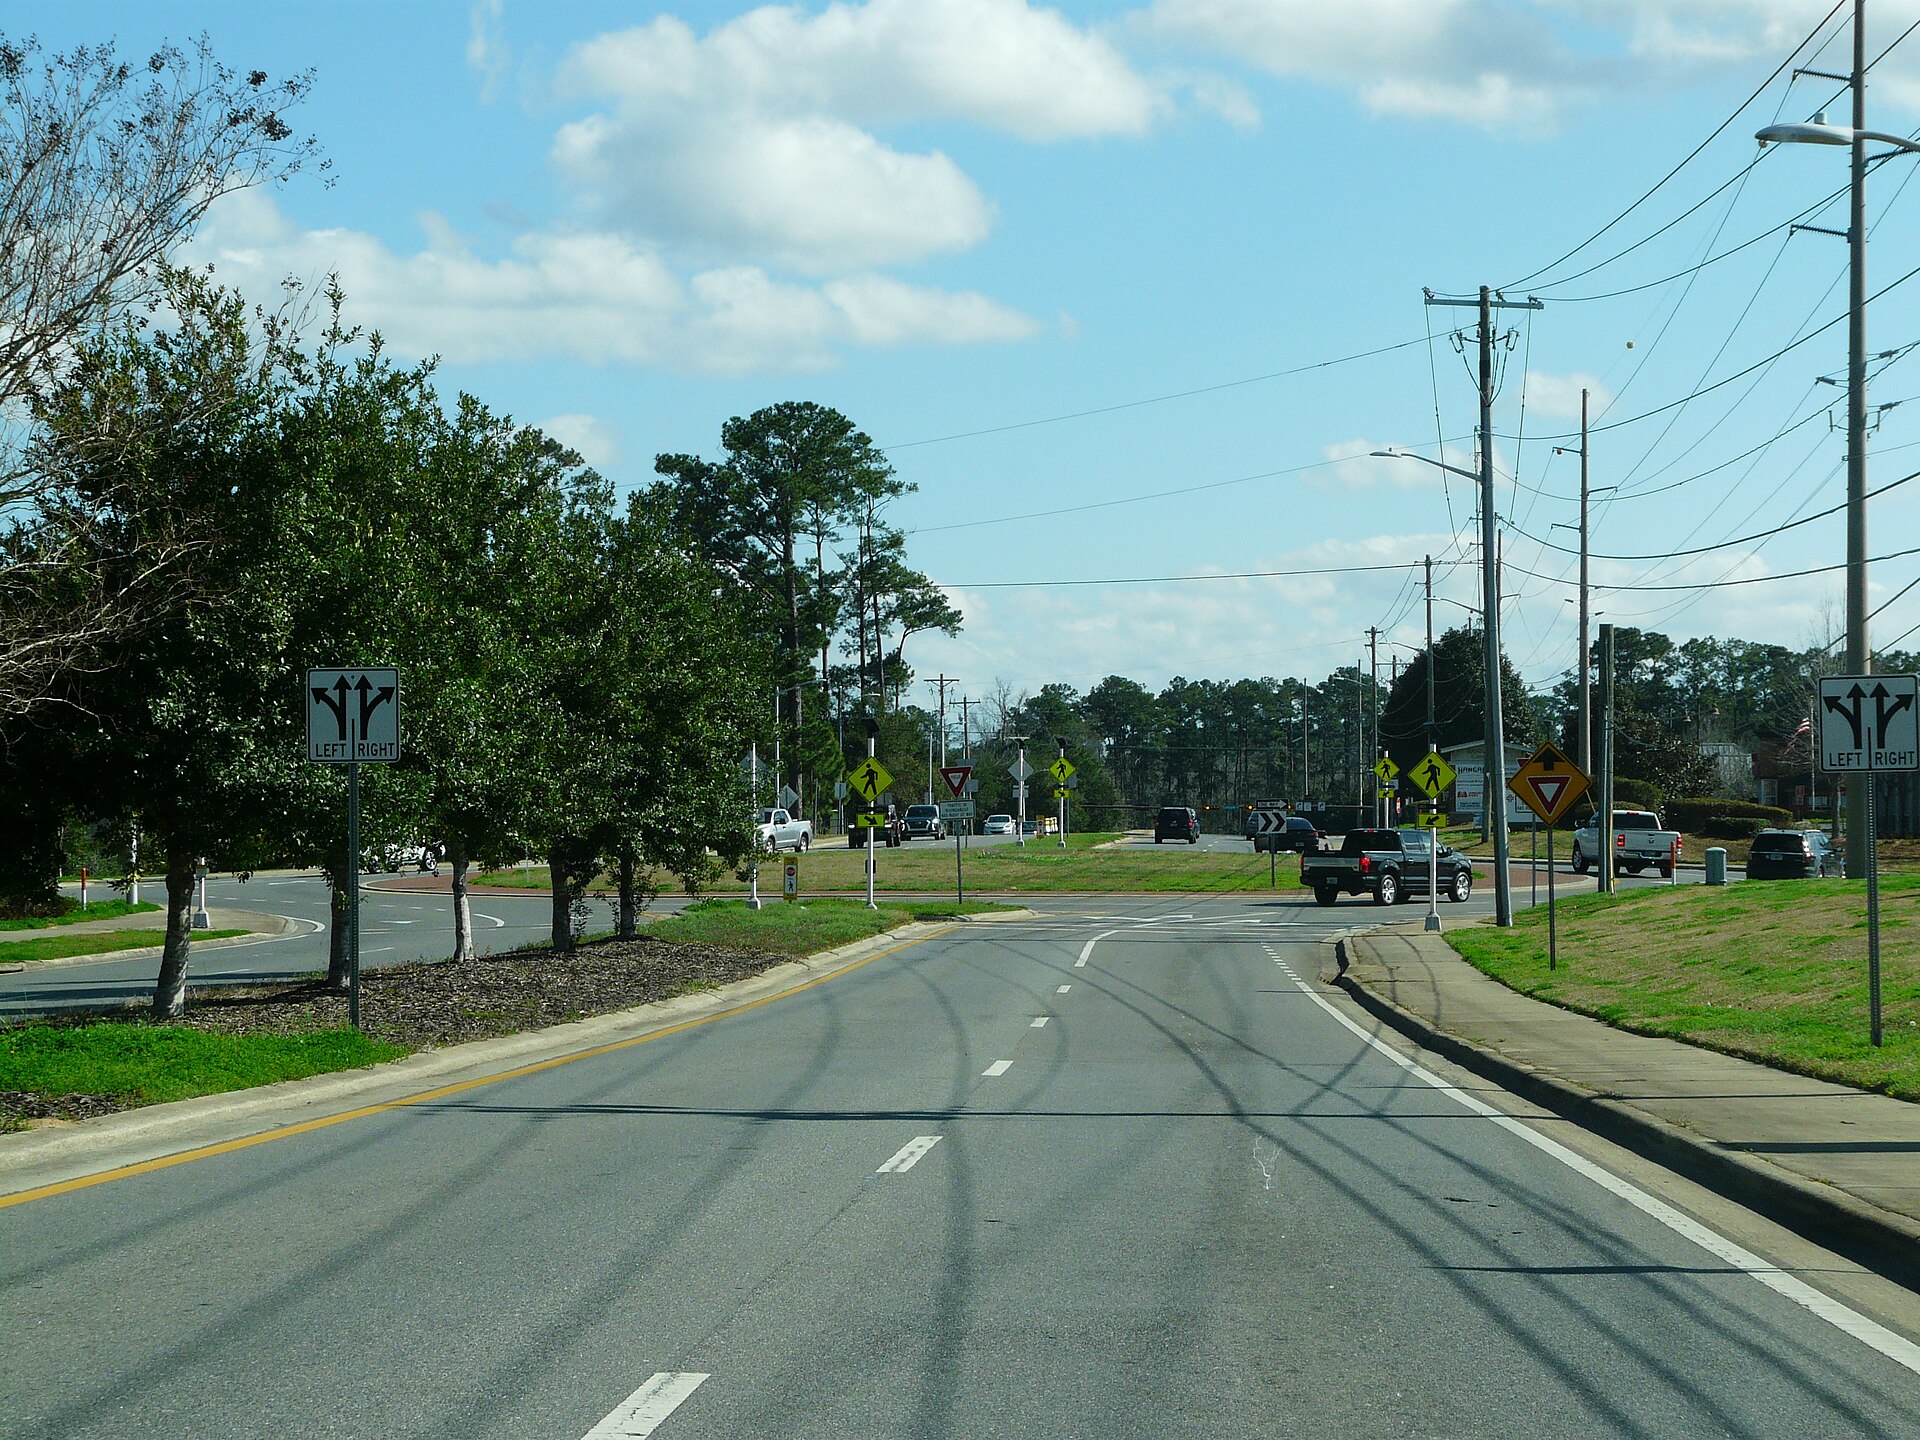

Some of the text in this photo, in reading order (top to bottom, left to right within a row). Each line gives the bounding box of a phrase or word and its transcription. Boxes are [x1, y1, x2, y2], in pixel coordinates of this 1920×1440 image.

[315, 742, 395, 758] LEFT RIGHT
[1828, 751, 1915, 767] LEFT RIGHT
